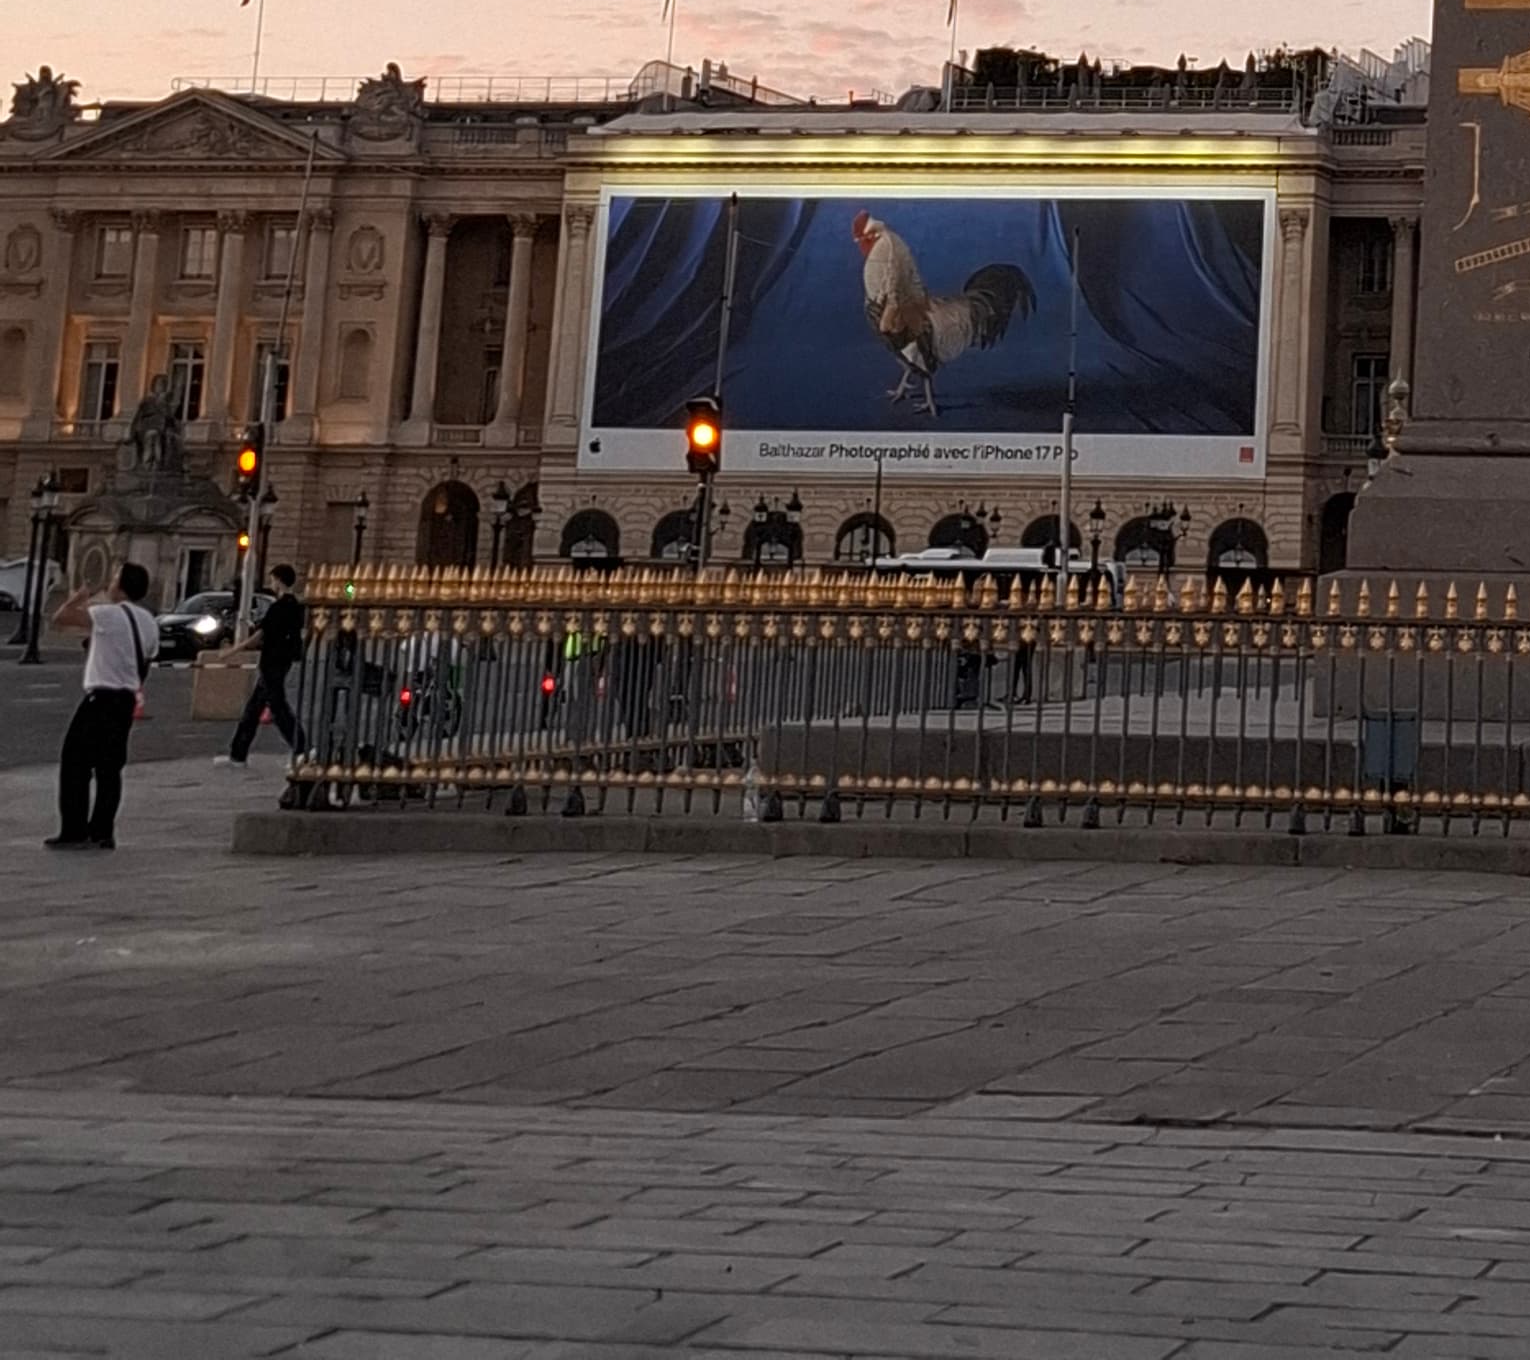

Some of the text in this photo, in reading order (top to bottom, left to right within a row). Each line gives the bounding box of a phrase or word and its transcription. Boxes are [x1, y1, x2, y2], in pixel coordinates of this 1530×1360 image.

[759, 442, 1079, 461] Balthazar Photographié avec l'iPhone 17 Po
